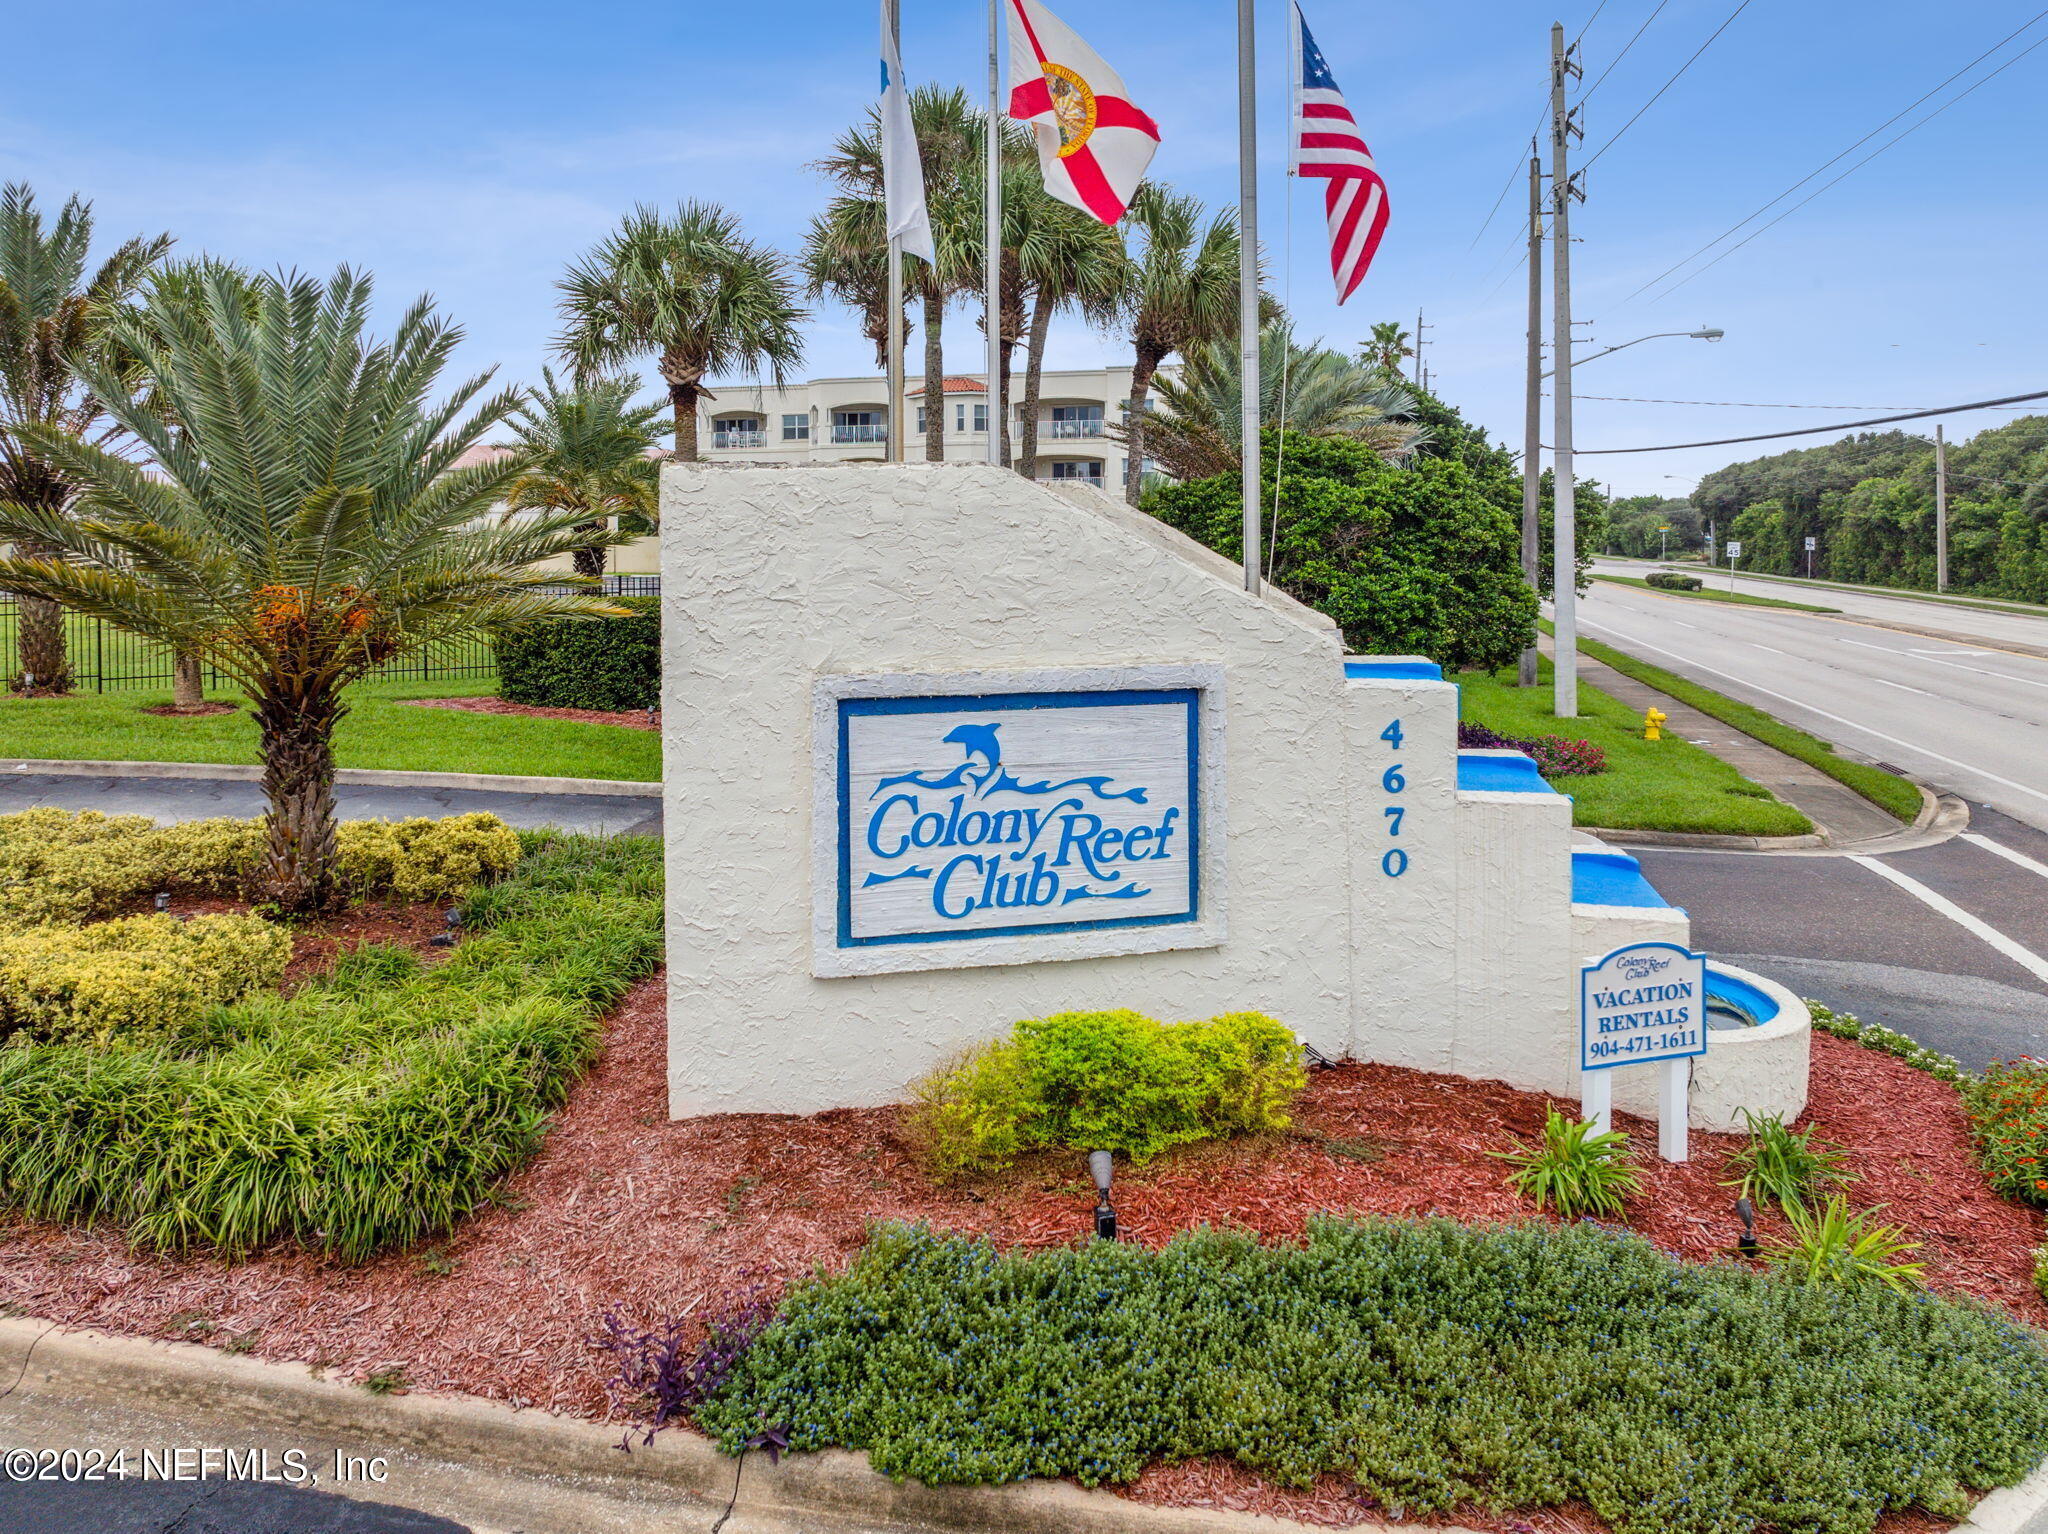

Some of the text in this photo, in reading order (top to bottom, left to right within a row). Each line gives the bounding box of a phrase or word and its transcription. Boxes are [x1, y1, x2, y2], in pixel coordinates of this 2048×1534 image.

[867, 794, 1179, 881] Colony Reef
[933, 852, 1060, 919] Club
[1616, 956, 1654, 969] Colony
[1625, 967, 1650, 980] Club
[1592, 982, 1693, 1008] VACATION
[1598, 1006, 1689, 1034] RENTALS
[1590, 1030, 1697, 1058] 904-471-1611
